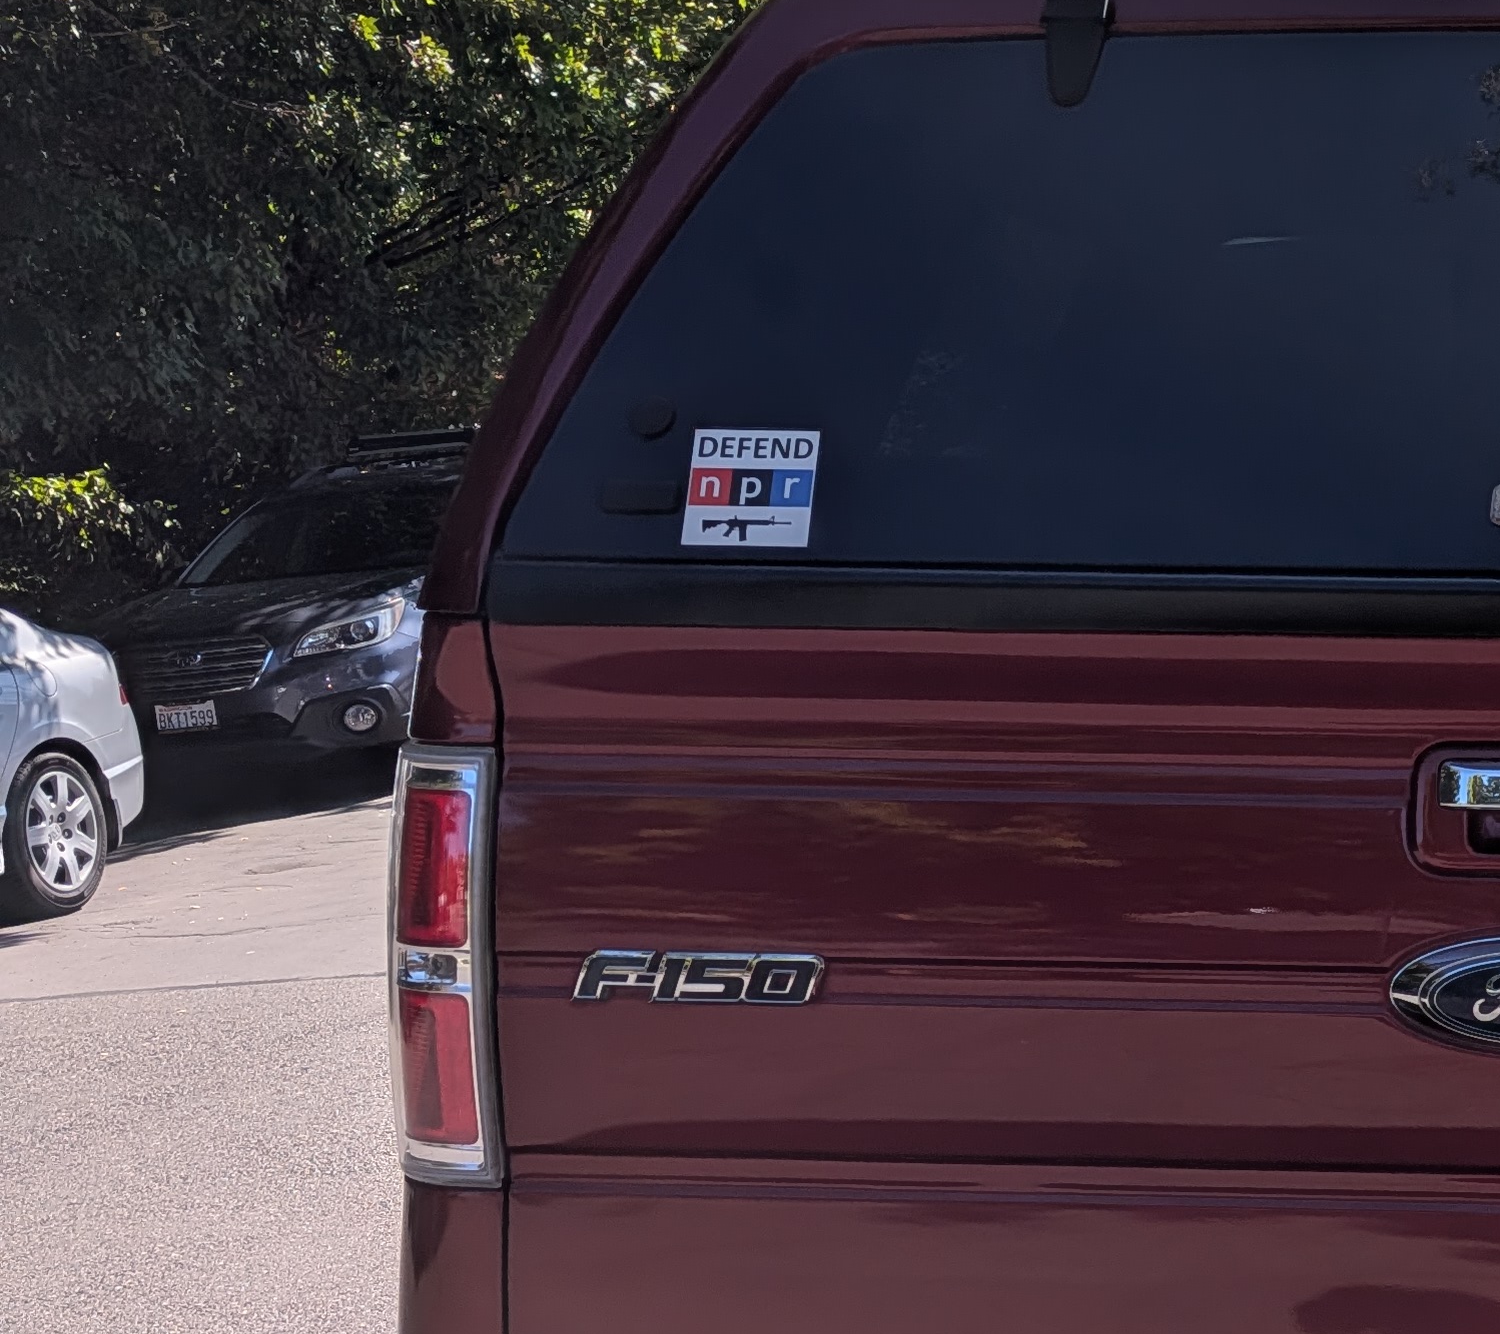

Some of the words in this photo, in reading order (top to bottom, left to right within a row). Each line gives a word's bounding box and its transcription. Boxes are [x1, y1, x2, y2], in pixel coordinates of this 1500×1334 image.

[698, 436, 814, 459] DEFEND
[699, 475, 801, 506] npr
[159, 709, 215, 729] BKT1599
[571, 949, 826, 1005] F-150
